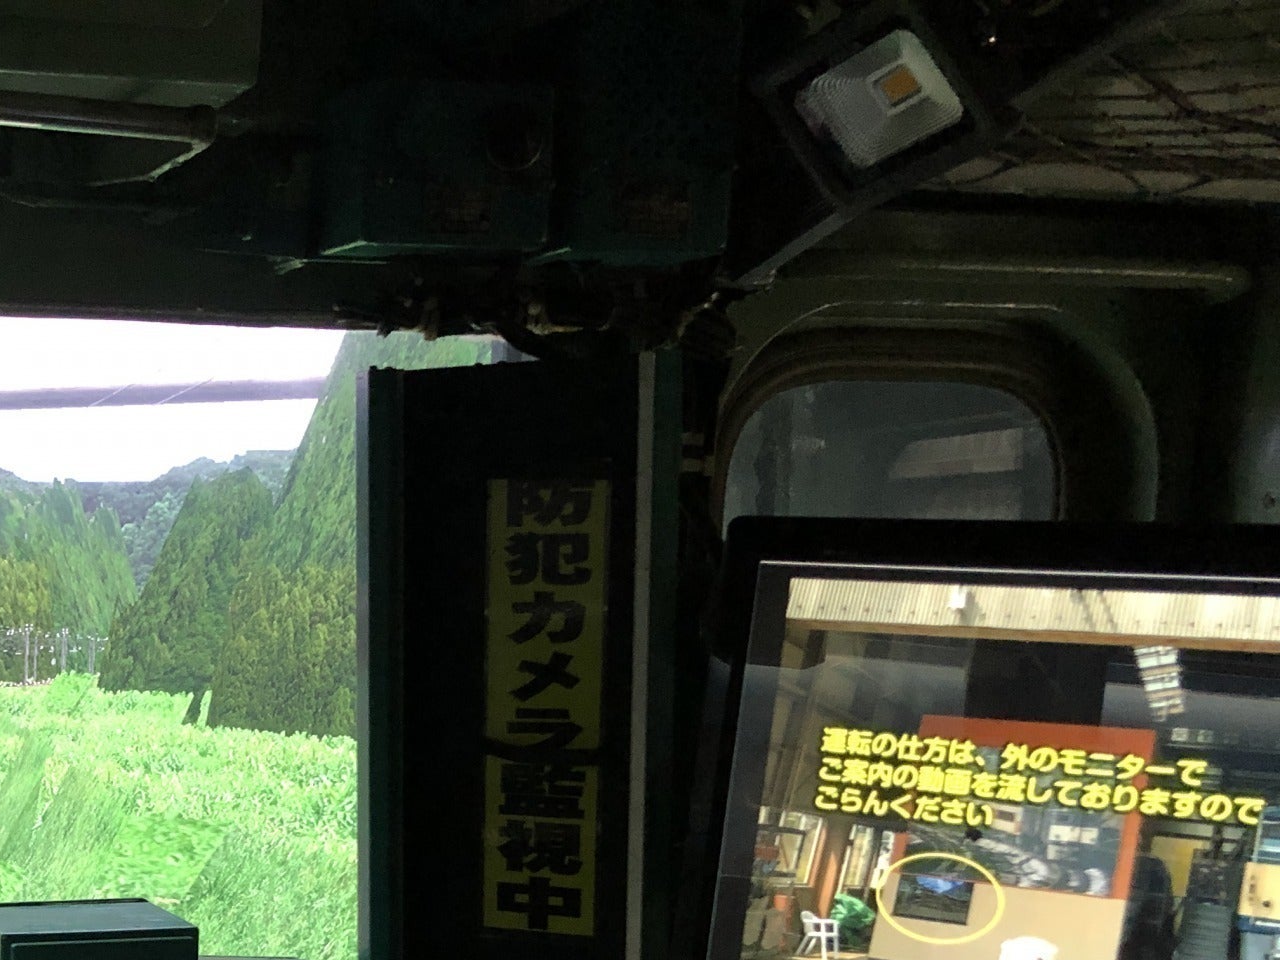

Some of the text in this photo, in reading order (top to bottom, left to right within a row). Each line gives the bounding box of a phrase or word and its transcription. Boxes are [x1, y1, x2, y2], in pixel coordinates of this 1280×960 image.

[821, 725, 1207, 788] 運転の仕方は、外のモニターで
[815, 785, 995, 828] ごらんください
[818, 757, 1266, 826] ご案内の動画を流しておりますので
